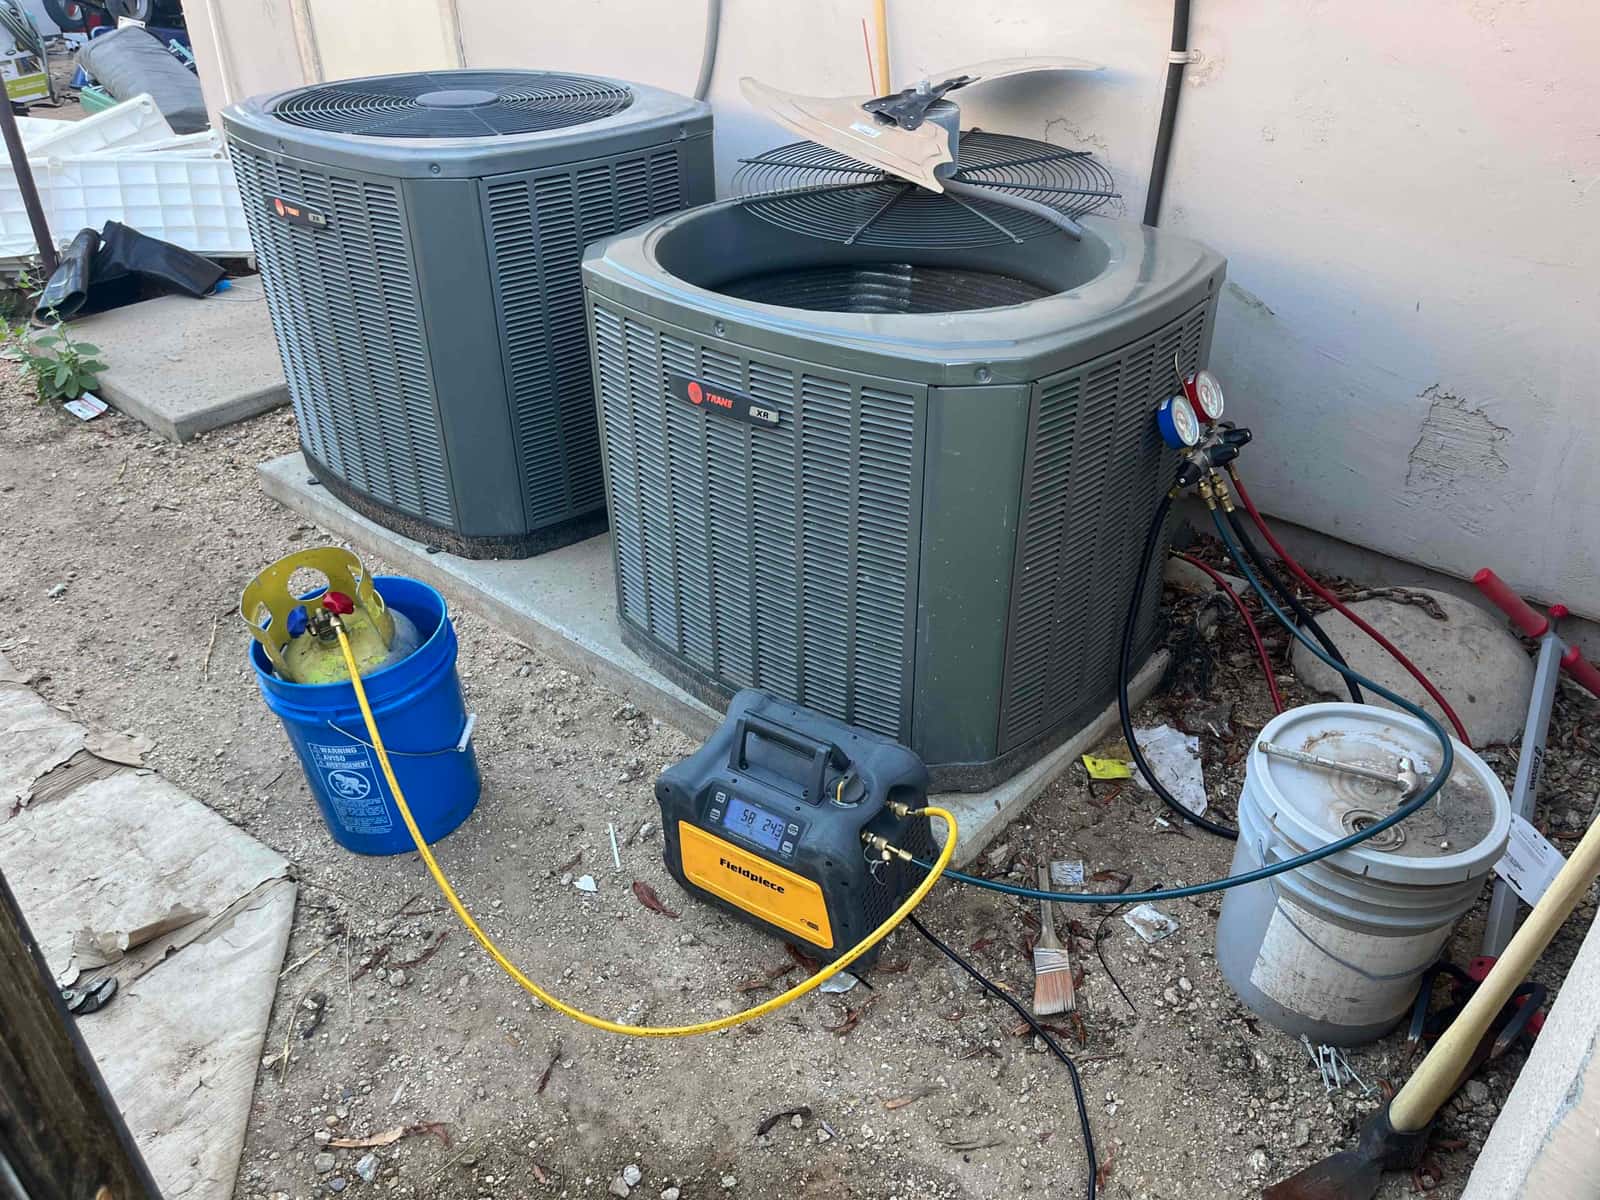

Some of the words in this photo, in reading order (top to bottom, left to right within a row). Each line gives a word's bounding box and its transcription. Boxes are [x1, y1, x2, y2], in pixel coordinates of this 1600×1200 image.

[706, 392, 733, 409] TRANE
[756, 409, 769, 419] XR
[323, 754, 346, 762] AVISO
[719, 858, 785, 894] Fieldpiece
